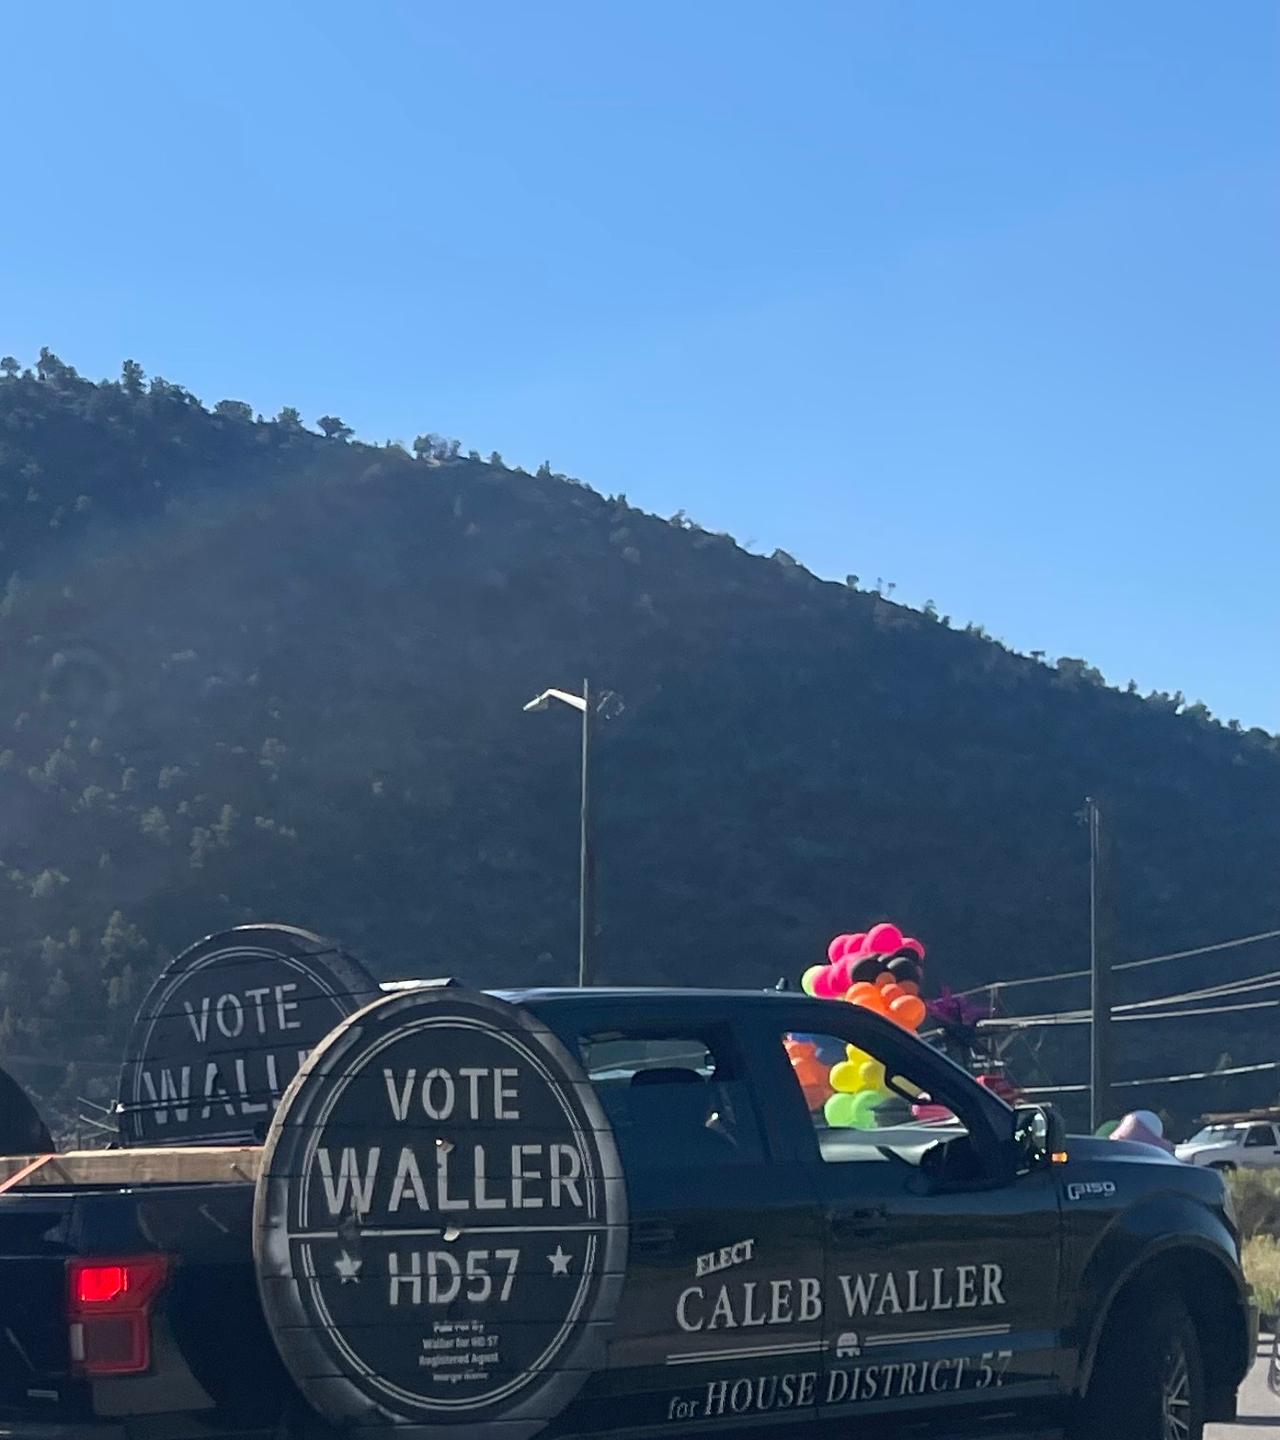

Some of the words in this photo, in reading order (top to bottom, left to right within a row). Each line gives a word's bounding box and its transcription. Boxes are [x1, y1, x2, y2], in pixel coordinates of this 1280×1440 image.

[184, 983, 301, 1043] VOTE
[383, 1067, 520, 1121] VOTE
[318, 1143, 584, 1216] WALLER
[388, 1248, 521, 1305] HD57
[695, 1239, 754, 1277] ELECT
[676, 1278, 823, 1332] CALEB
[839, 1263, 1007, 1318] WALLER
[668, 1396, 699, 1420] for
[704, 1371, 818, 1416] HOUSE
[826, 1356, 970, 1403] DISTRICT
[976, 1351, 1013, 1389] 57
